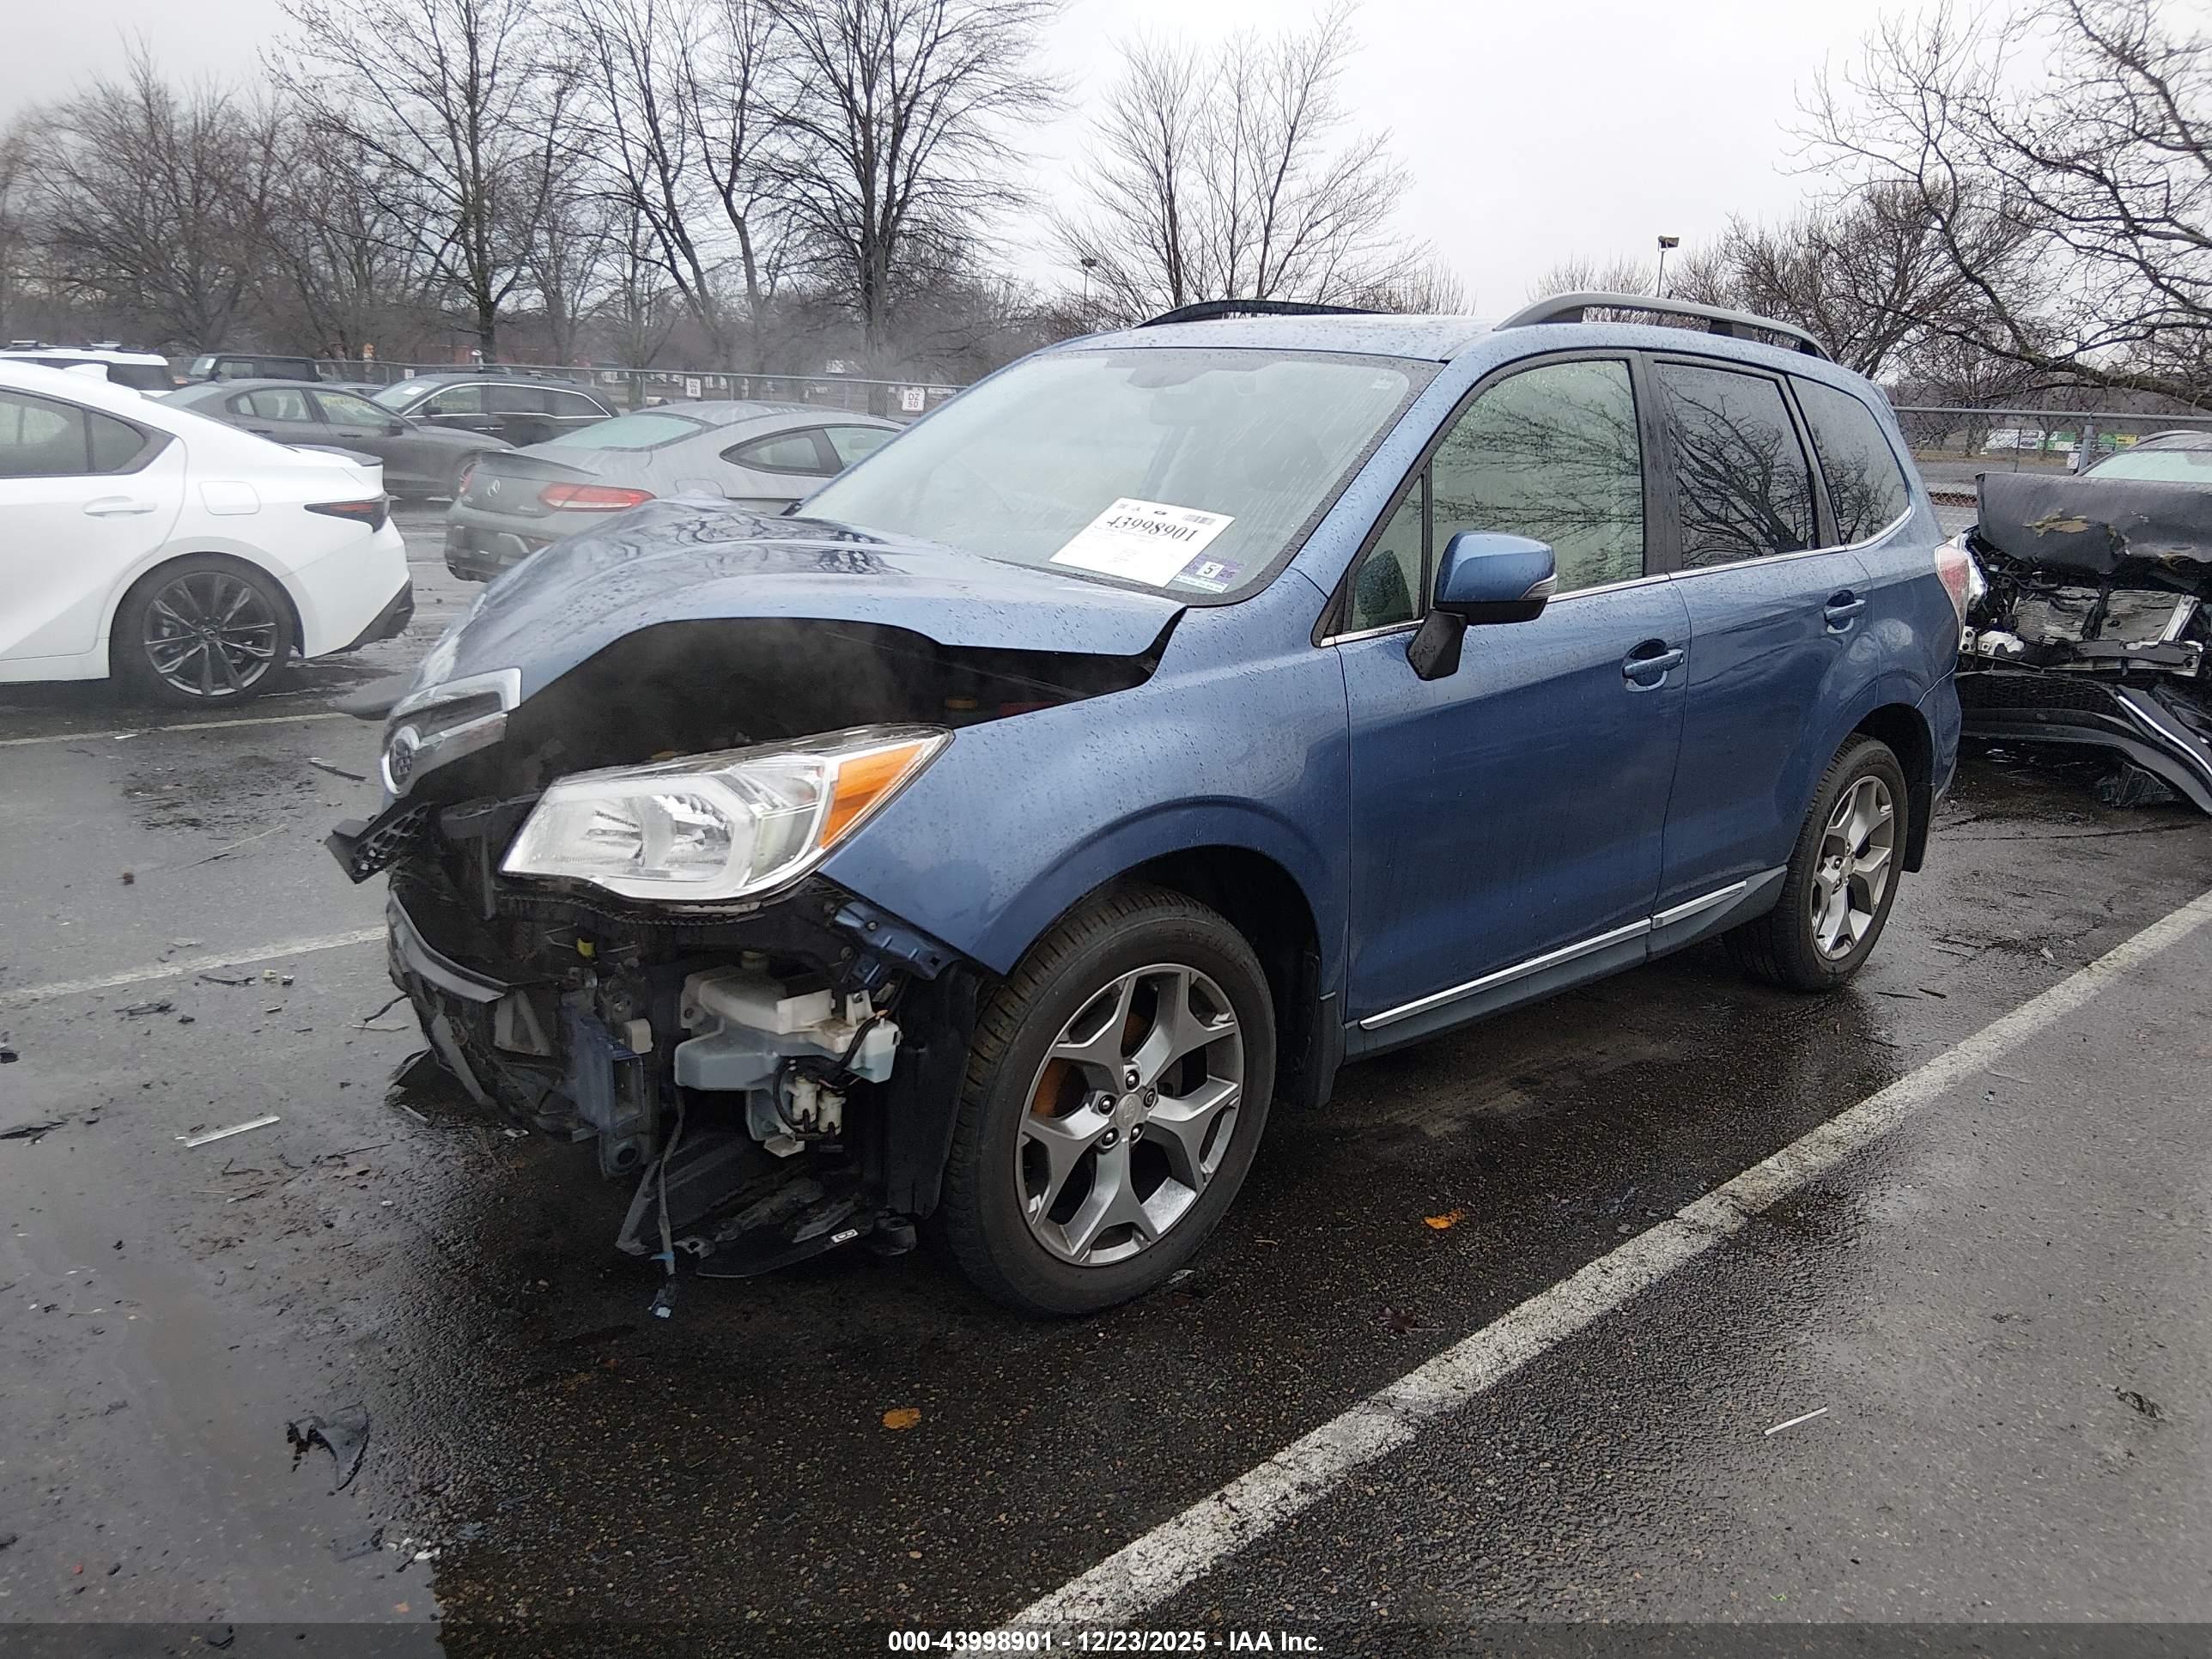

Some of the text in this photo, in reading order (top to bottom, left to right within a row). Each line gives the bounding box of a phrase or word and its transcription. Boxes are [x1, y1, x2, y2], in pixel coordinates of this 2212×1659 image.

[908, 392, 921, 401] DZ
[1107, 515, 1199, 542] 43998901
[1203, 563, 1217, 574] 5
